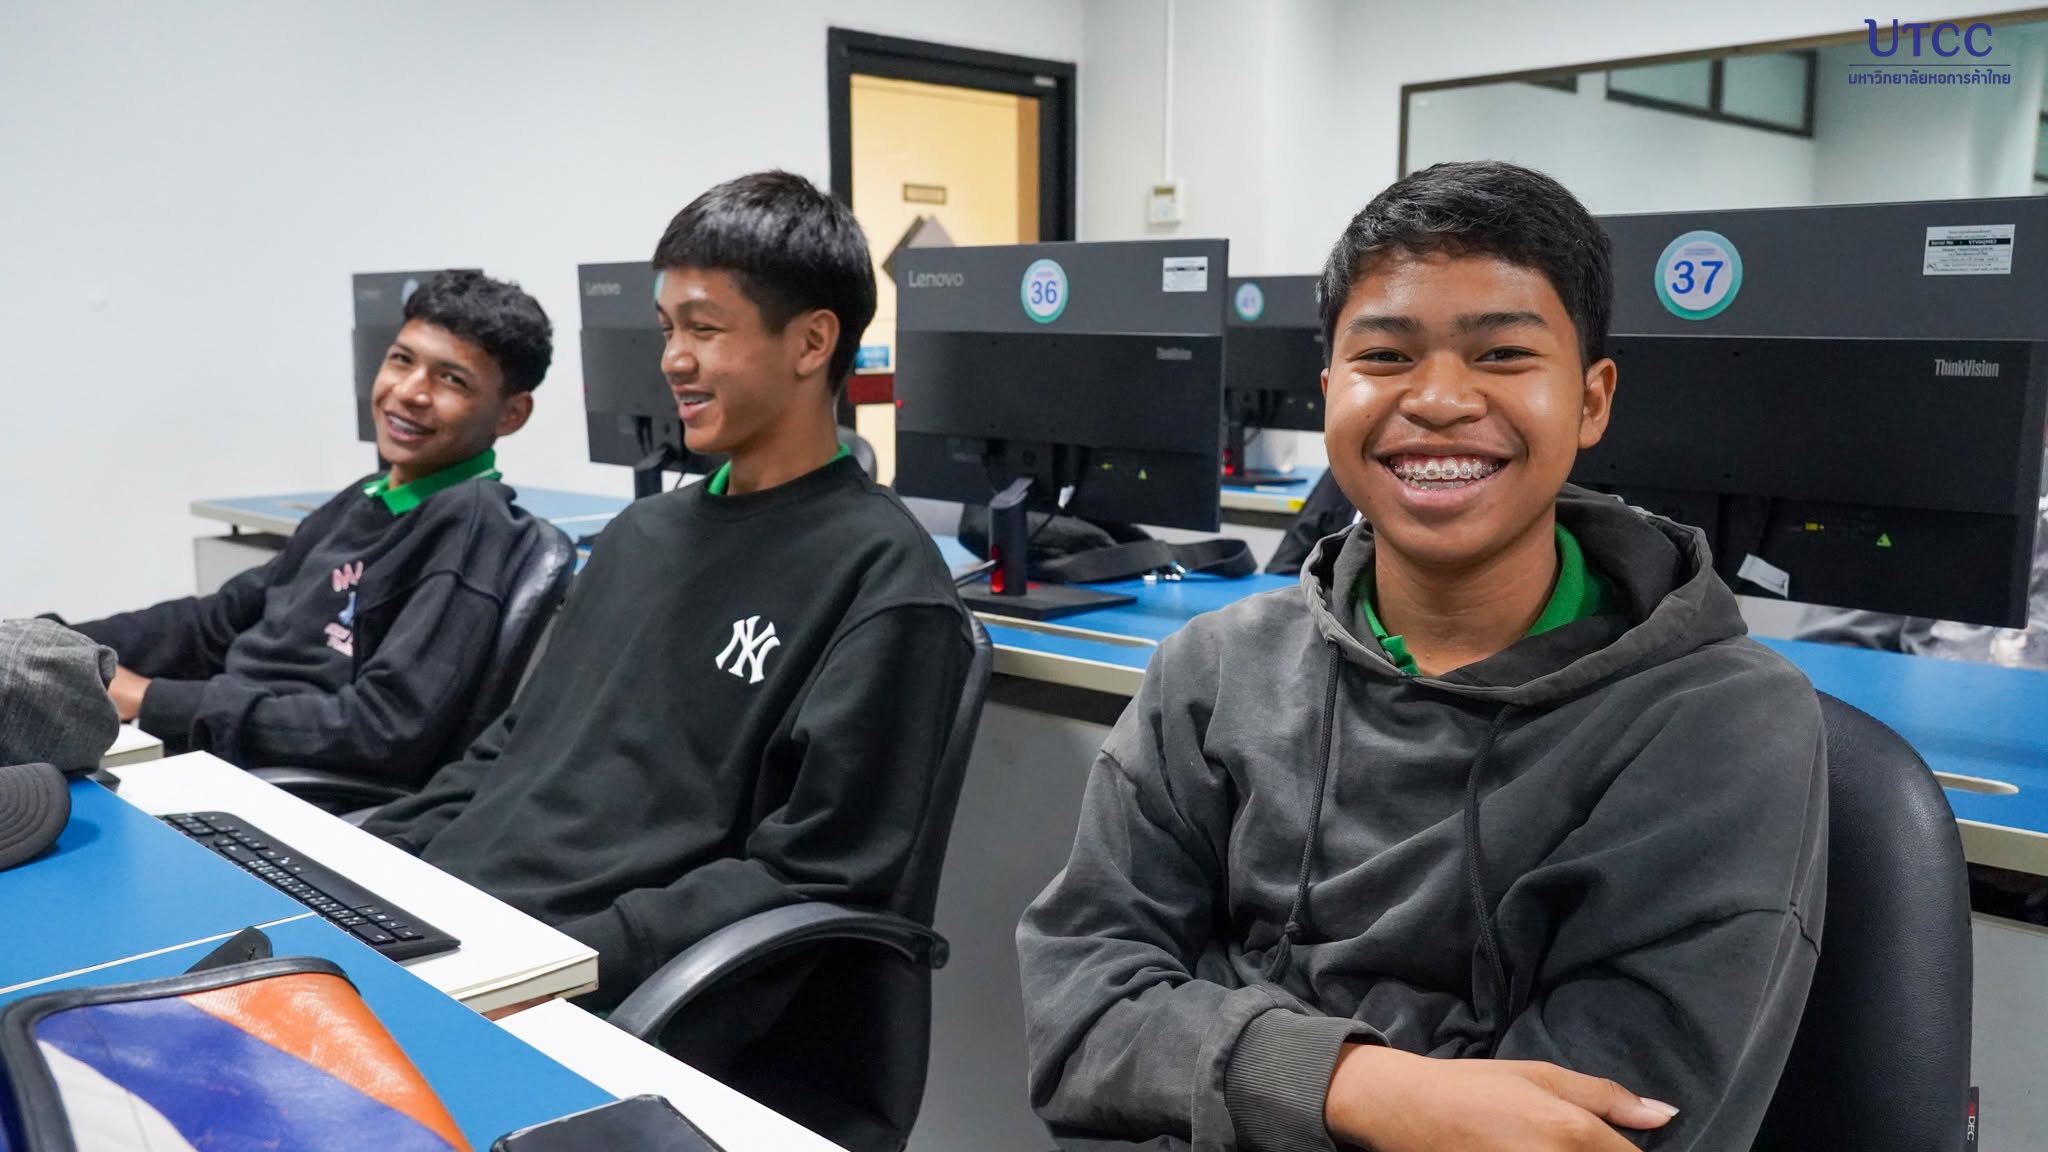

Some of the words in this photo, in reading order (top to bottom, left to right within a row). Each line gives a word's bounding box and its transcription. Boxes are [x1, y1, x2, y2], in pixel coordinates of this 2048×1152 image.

[908, 269, 964, 288] Lenovo
[1671, 260, 1724, 295] 37
[1031, 280, 1057, 305] 36
[1934, 359, 2000, 377] ThinkVision
[715, 615, 781, 684] NY
